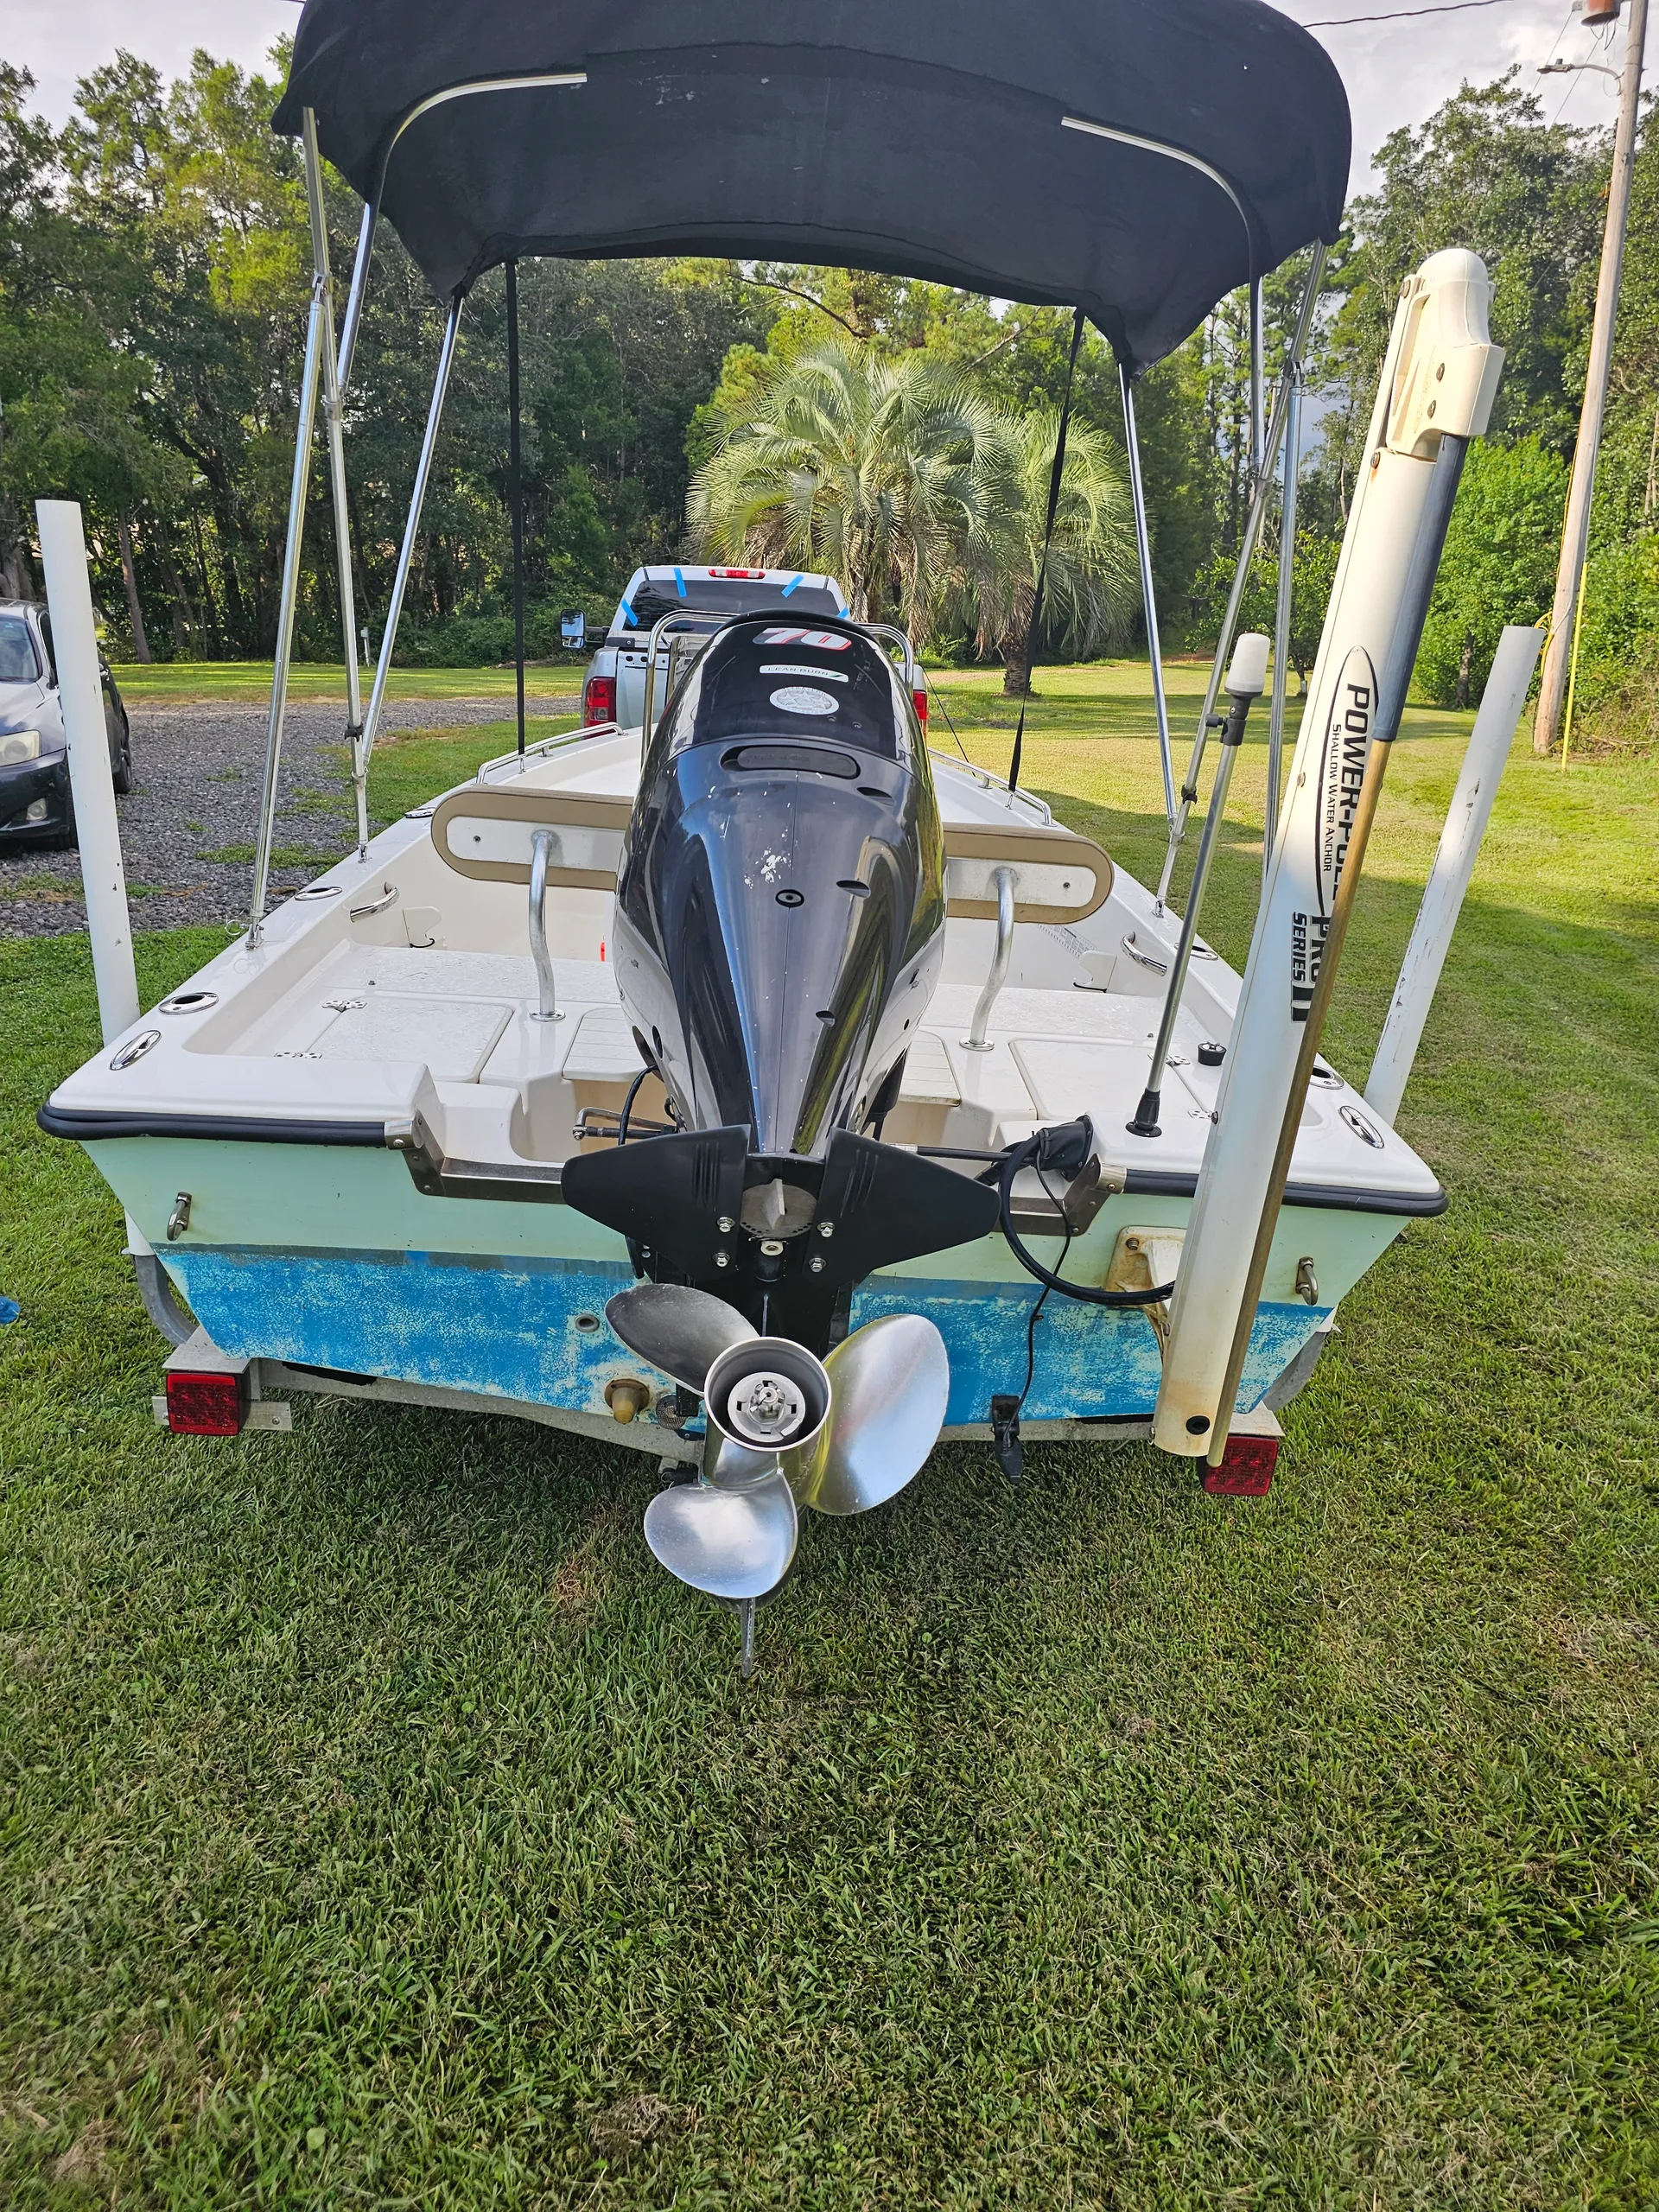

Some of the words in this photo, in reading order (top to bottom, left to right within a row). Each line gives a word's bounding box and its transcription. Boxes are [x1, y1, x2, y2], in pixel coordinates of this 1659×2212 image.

[753, 627, 852, 651] 70
[799, 668, 829, 677] BURN
[1328, 723, 1342, 781] SHALLOW
[1326, 784, 1338, 823] WATER
[1332, 683, 1370, 901] POWER-POL
[1323, 826, 1336, 872] ANCHOR
[1292, 911, 1307, 982] SERIES
